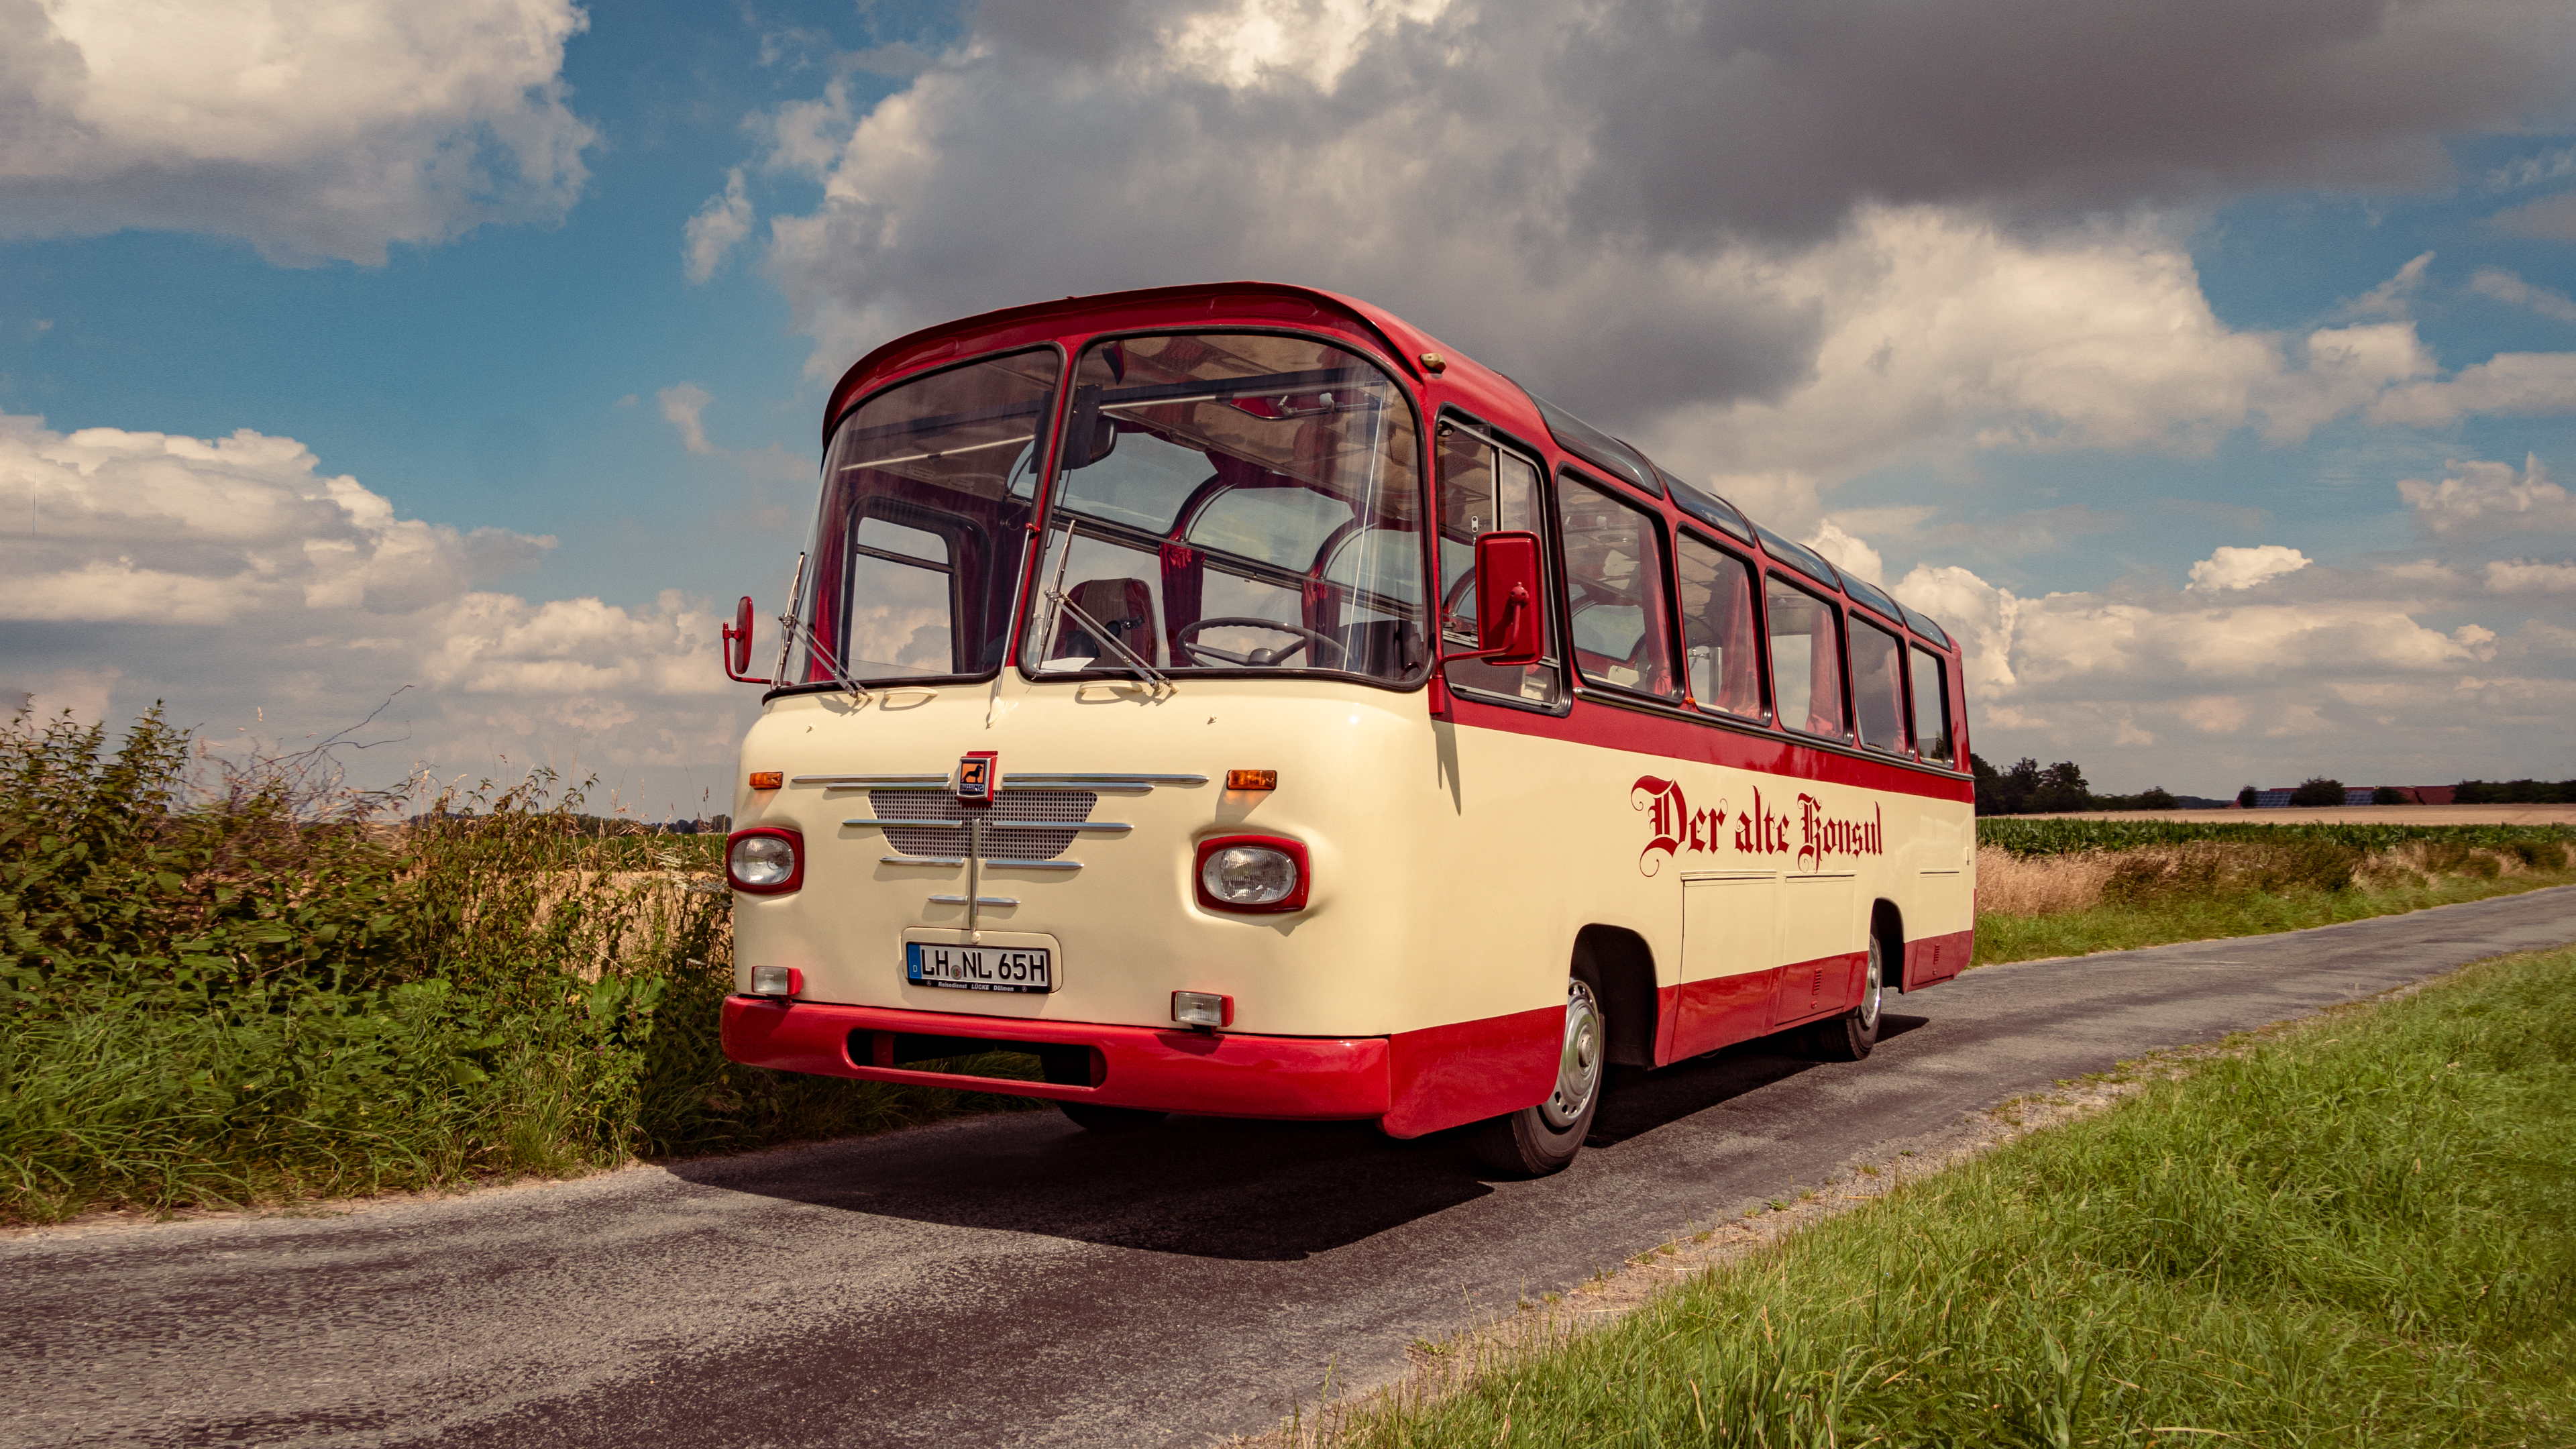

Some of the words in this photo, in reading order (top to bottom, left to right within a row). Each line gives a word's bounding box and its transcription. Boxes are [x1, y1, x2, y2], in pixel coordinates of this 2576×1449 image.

[1631, 775, 1728, 877] Der
[1734, 785, 1791, 855] alte
[1797, 792, 1883, 873] Konsul
[913, 965, 918, 973] D
[922, 949, 949, 976] LH
[963, 951, 992, 978] NL
[998, 953, 1045, 981] 65H
